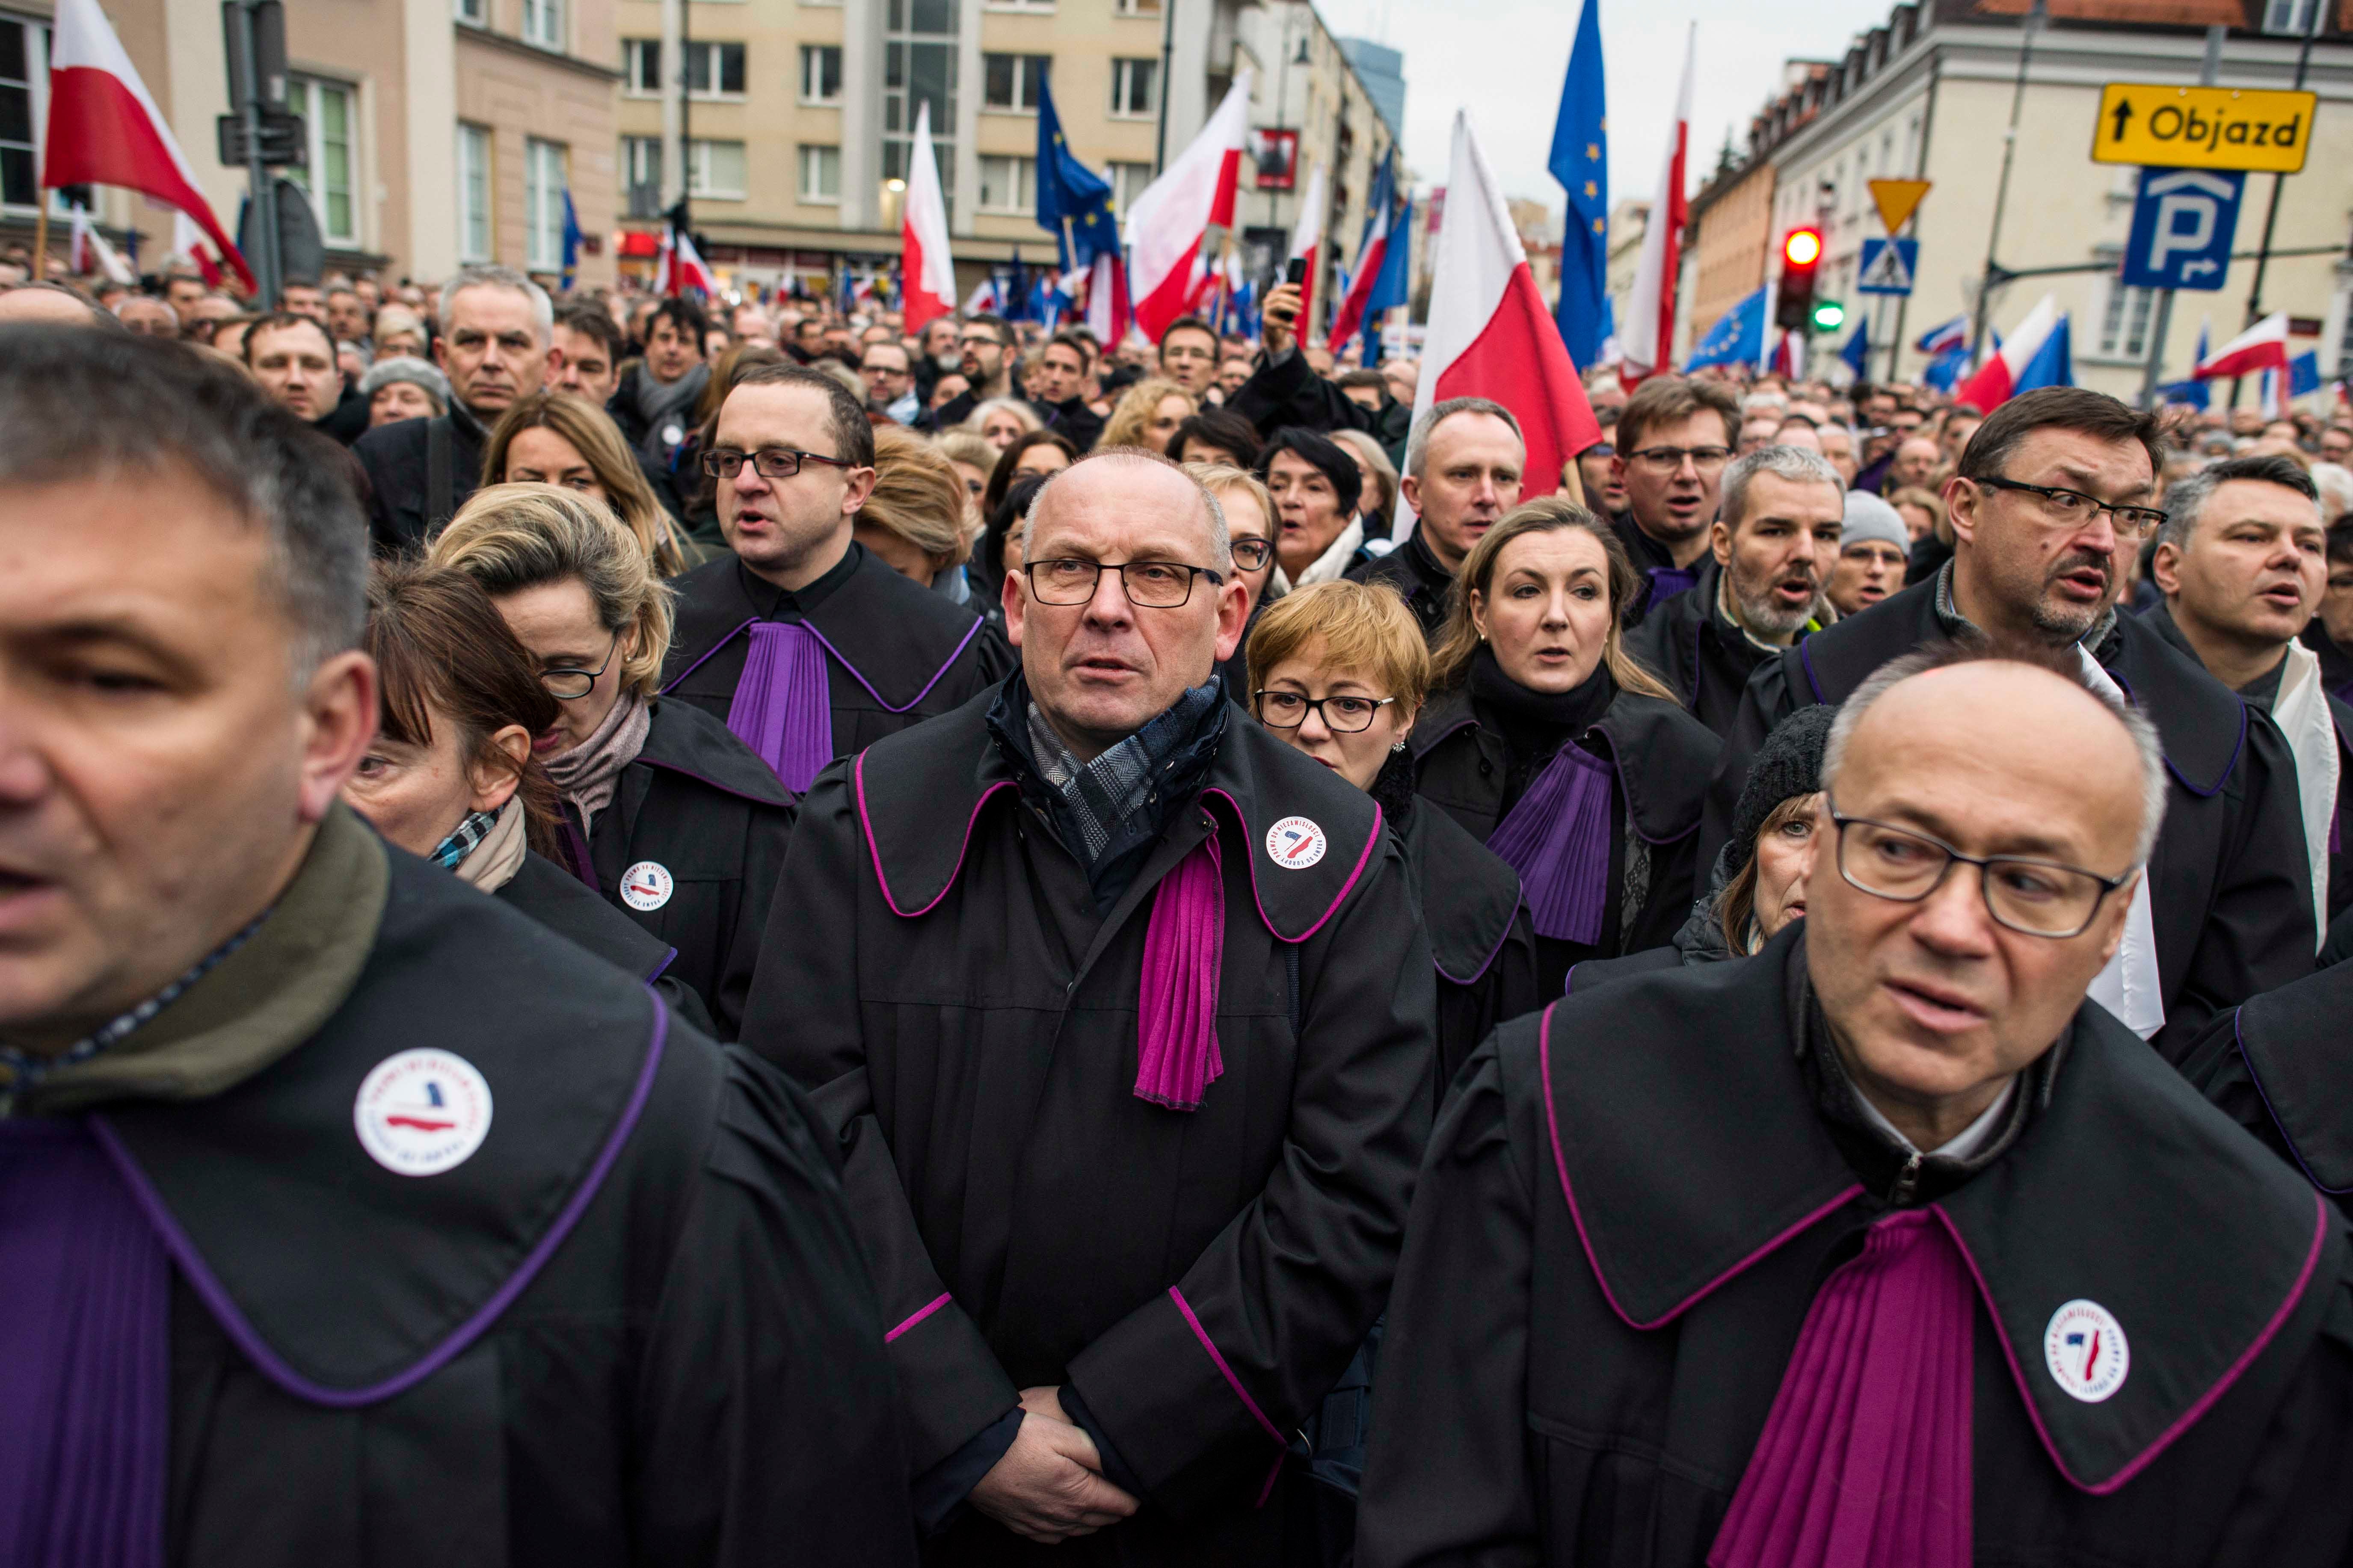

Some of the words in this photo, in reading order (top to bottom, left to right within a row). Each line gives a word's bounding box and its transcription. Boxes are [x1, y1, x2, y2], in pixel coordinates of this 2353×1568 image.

[2149, 105, 2301, 153] Objazd
[2148, 193, 2218, 272] P
[1270, 840, 1281, 858] PRAWO
[1276, 820, 1320, 837] NIEZAWISŁOŚCI
[1313, 840, 1323, 857] PRAWO
[1280, 858, 1304, 866] EUROPY
